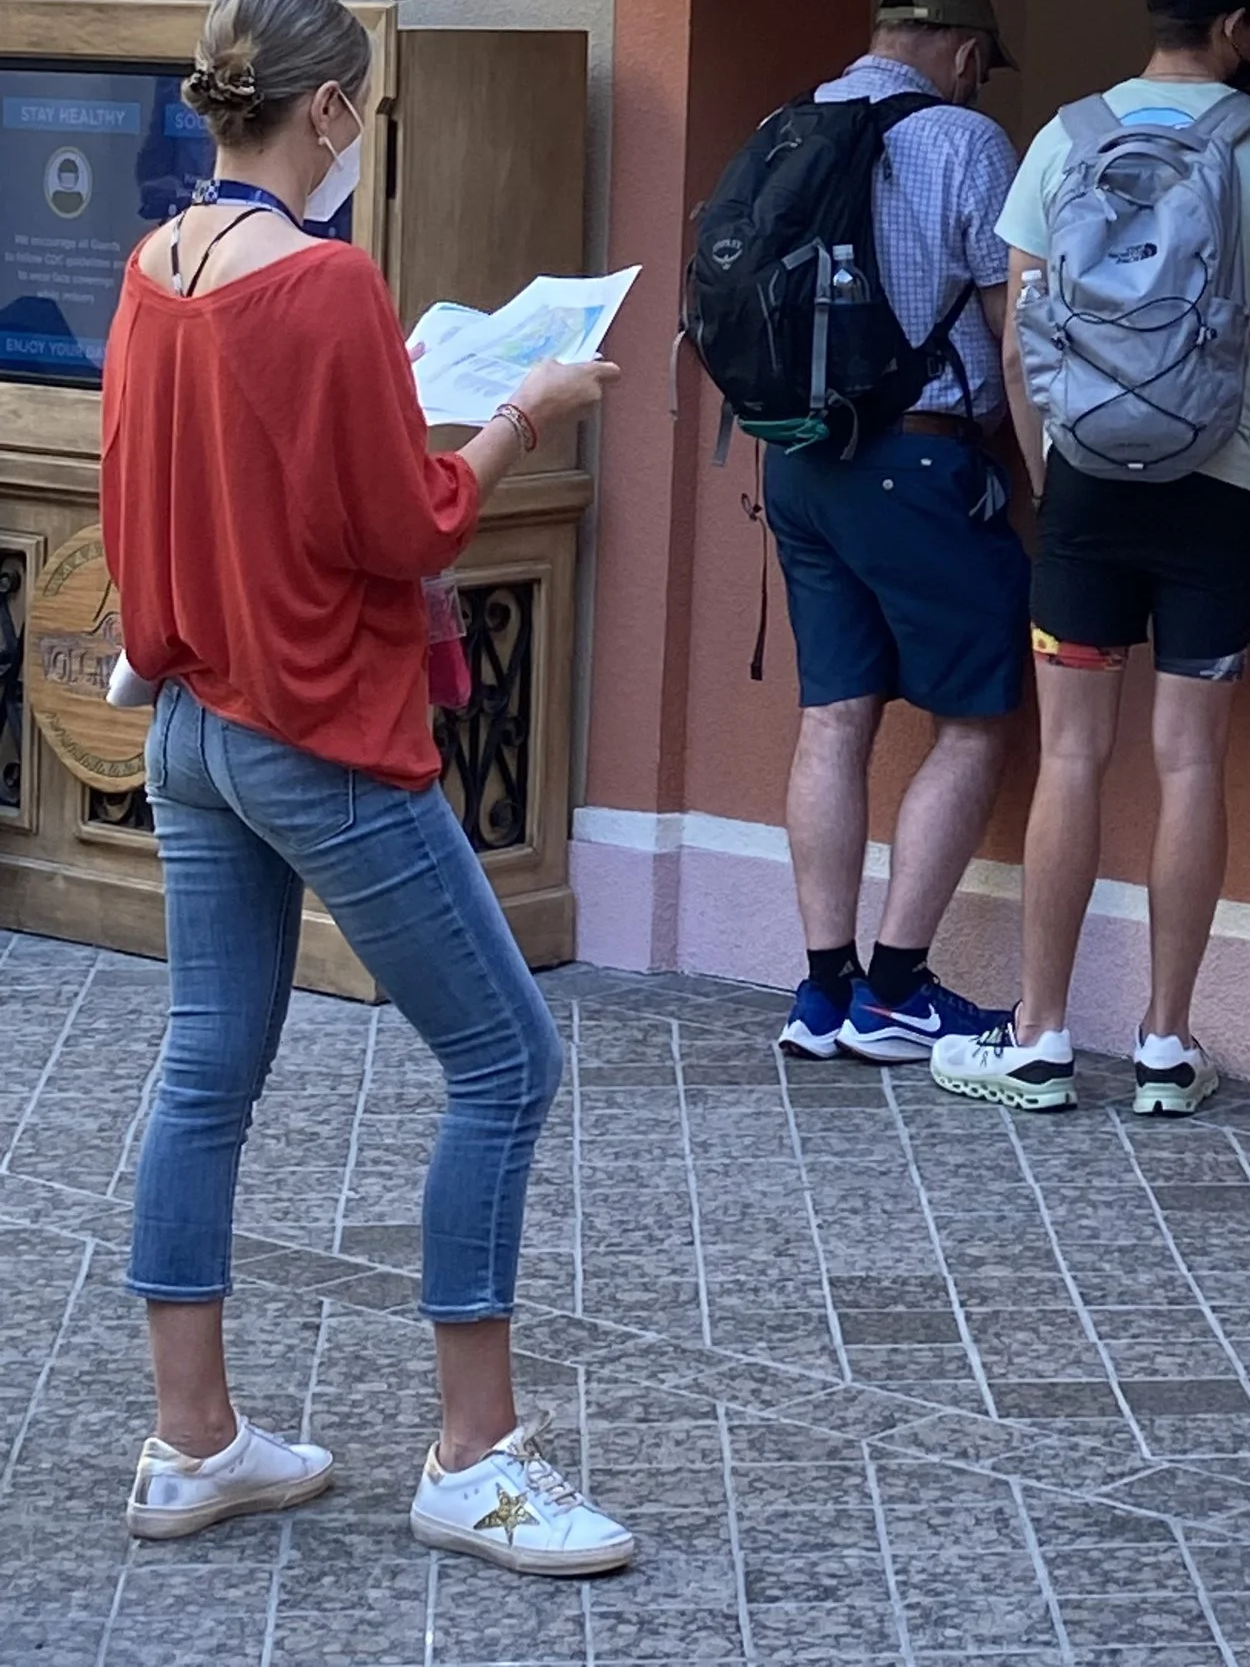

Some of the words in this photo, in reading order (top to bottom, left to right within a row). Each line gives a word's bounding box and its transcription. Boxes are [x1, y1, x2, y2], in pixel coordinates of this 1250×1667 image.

[21, 106, 55, 122] STAY
[59, 108, 126, 127] HEALTHY
[174, 111, 208, 130] SOC
[6, 338, 46, 355] ENJOY
[49, 342, 85, 358] YOUR
[86, 345, 106, 360] DA
